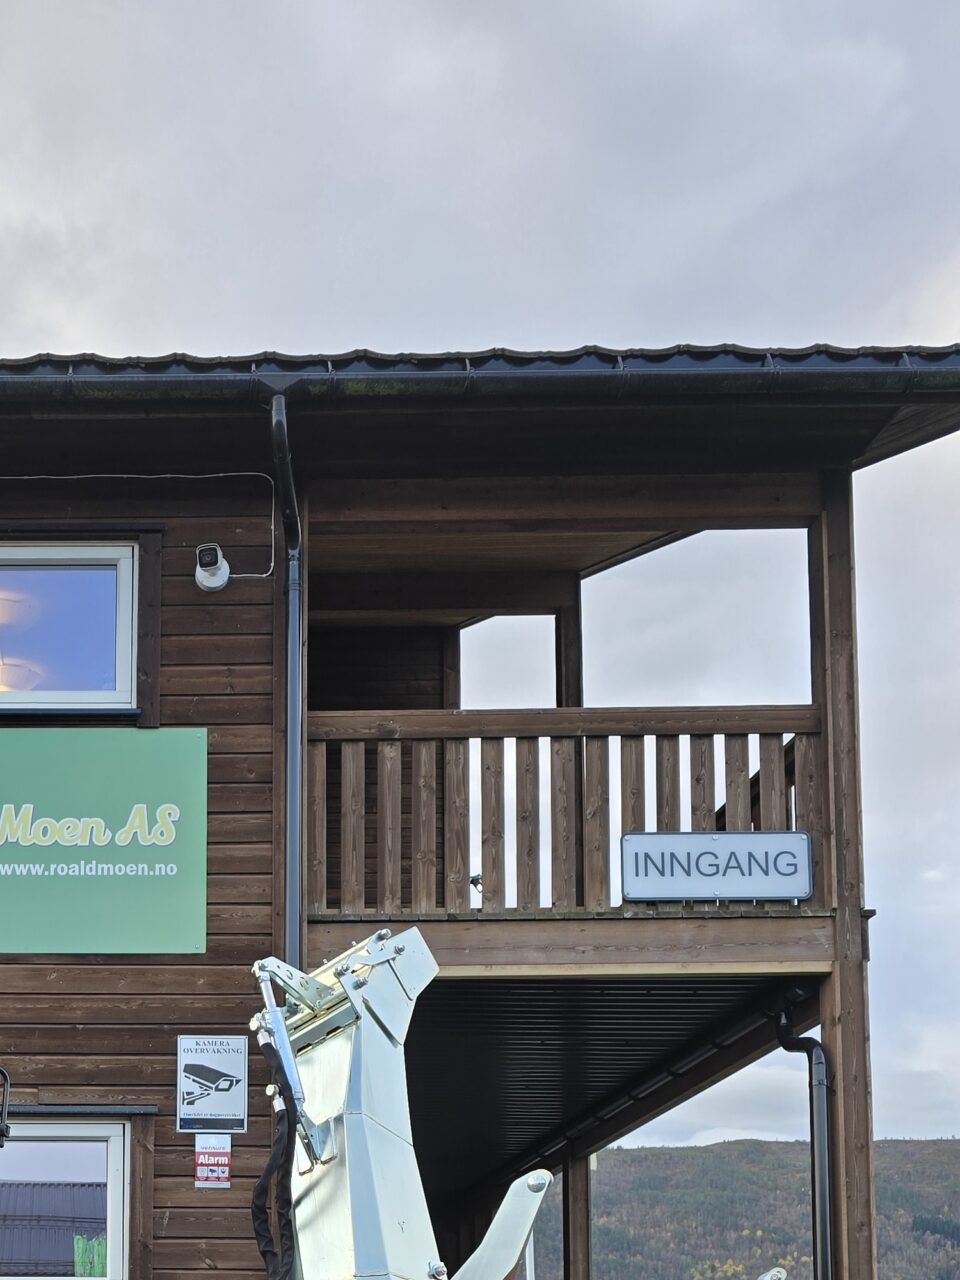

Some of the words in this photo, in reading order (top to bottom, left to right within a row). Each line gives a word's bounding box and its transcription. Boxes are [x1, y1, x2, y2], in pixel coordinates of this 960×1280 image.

[115, 803, 180, 846] AS
[634, 851, 798, 877] INNGANG
[198, 1154, 229, 1165] Alarm
